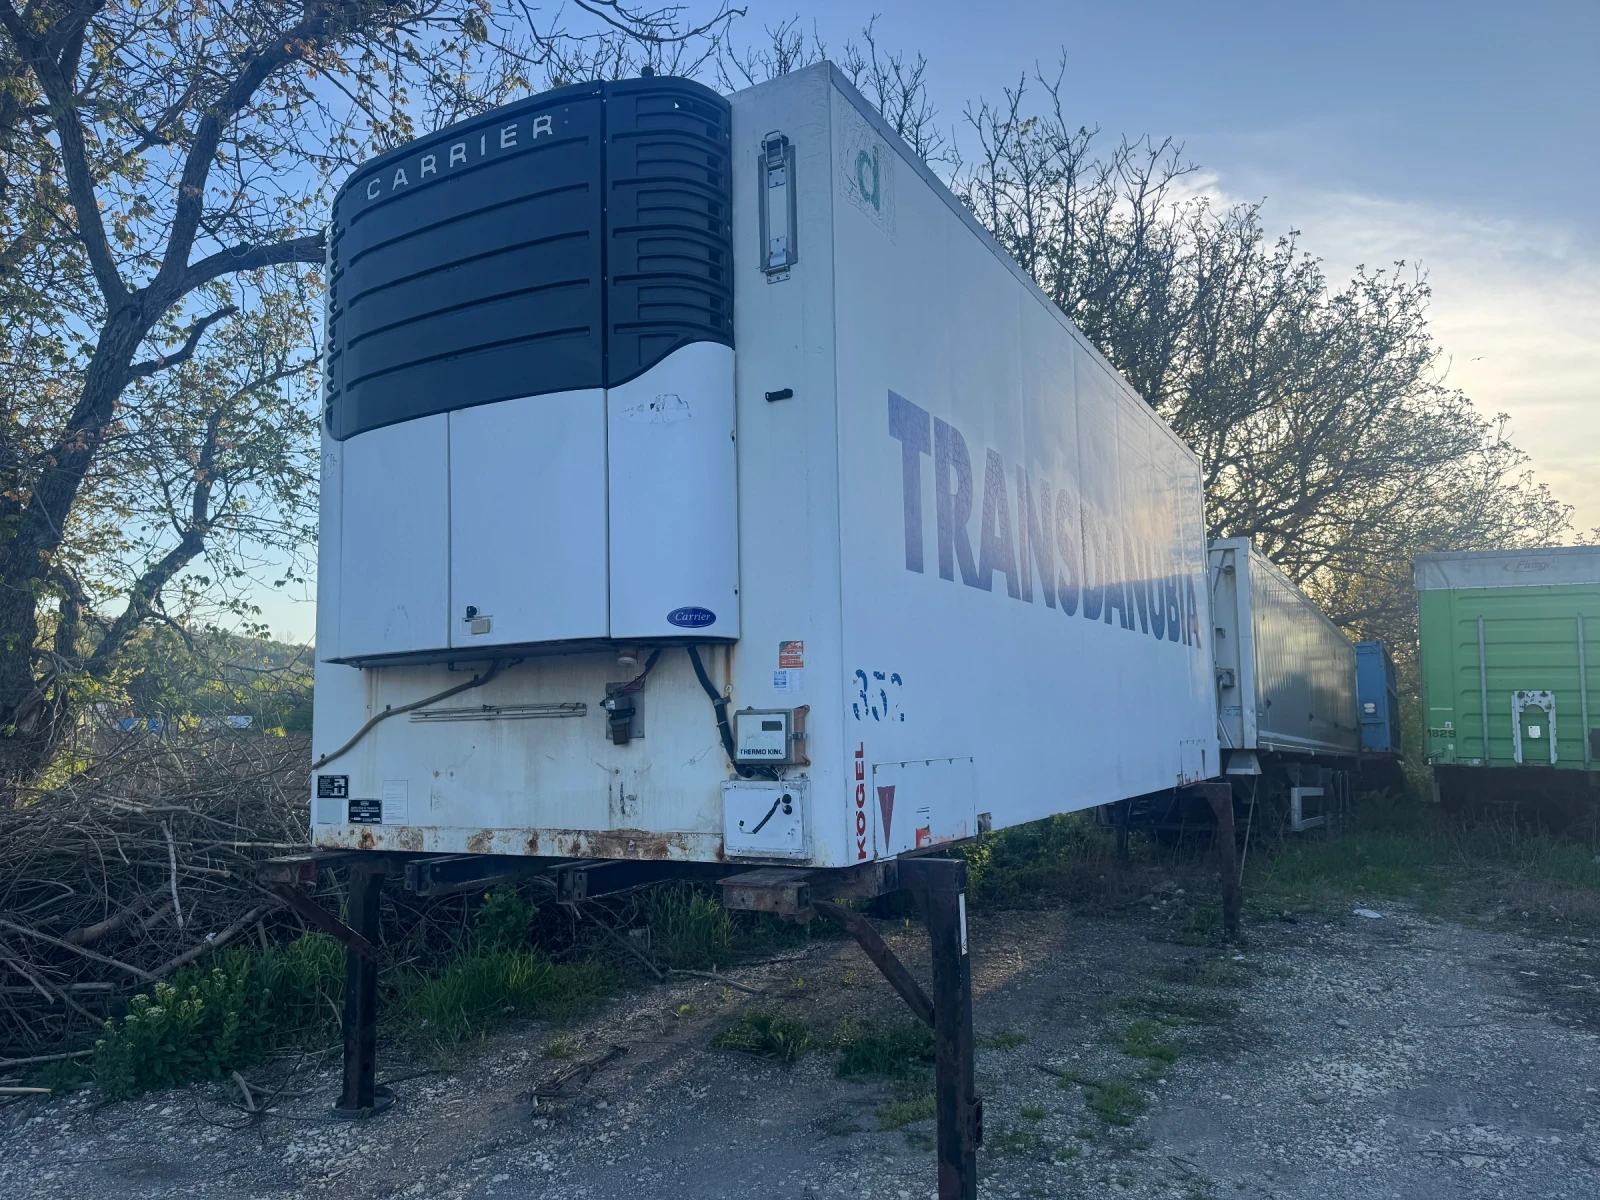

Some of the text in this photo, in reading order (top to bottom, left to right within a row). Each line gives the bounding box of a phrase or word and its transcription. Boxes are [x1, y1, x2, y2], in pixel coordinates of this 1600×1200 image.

[366, 114, 553, 200] CARRIER
[887, 388, 1202, 649] TRANSDANUBIA
[675, 612, 711, 621] Carrier
[1427, 729, 1457, 738] 1829
[740, 748, 767, 756] THERMO
